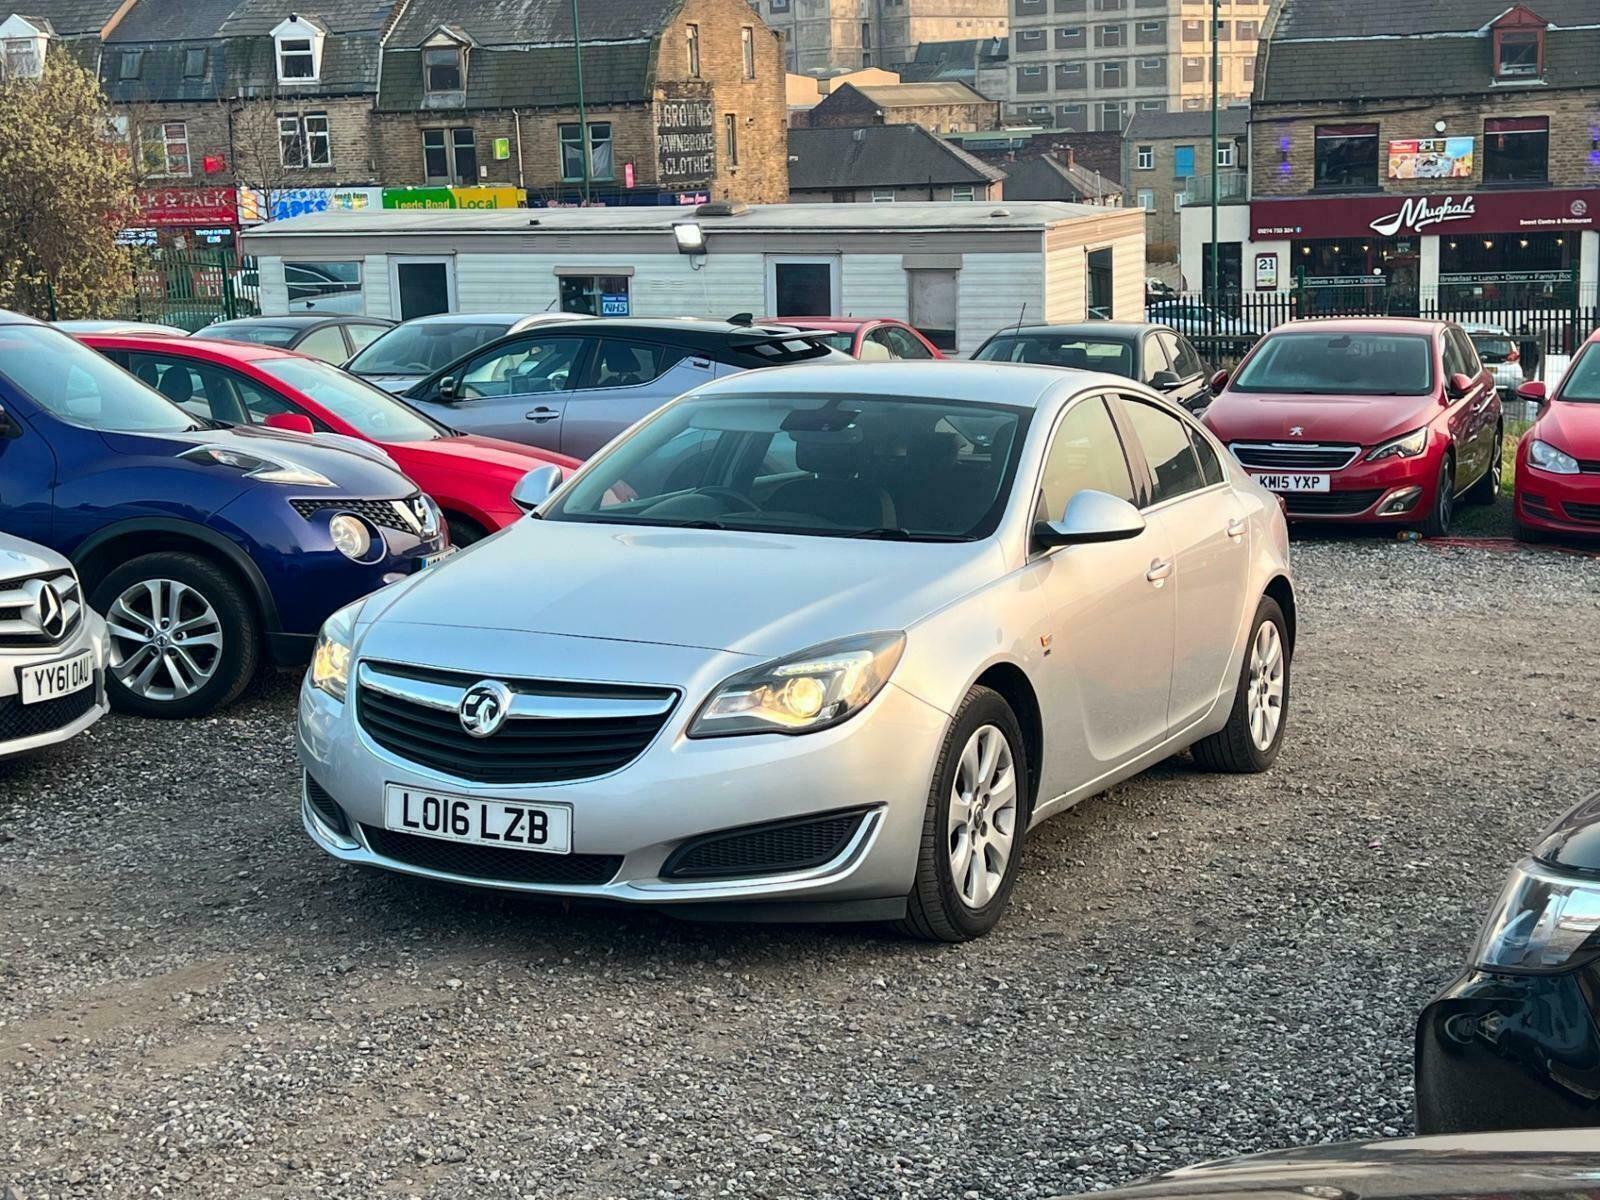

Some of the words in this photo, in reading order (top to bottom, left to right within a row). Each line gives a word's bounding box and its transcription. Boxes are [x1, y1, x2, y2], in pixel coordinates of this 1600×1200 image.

[179, 190, 228, 208] TALK
[395, 199, 420, 209] Leeds
[425, 198, 450, 209] Road
[459, 194, 498, 209] Local
[1369, 195, 1476, 236] Mughals
[1478, 274, 1499, 282] Lunch
[1506, 273, 1528, 281] Dinner
[604, 303, 626, 313] NHS
[1260, 475, 1289, 489] KM15
[1294, 475, 1320, 489] YXP
[35, 664, 69, 696] YY61
[72, 657, 89, 687] OAU
[403, 792, 470, 836] LO16
[481, 804, 548, 845] LZB
